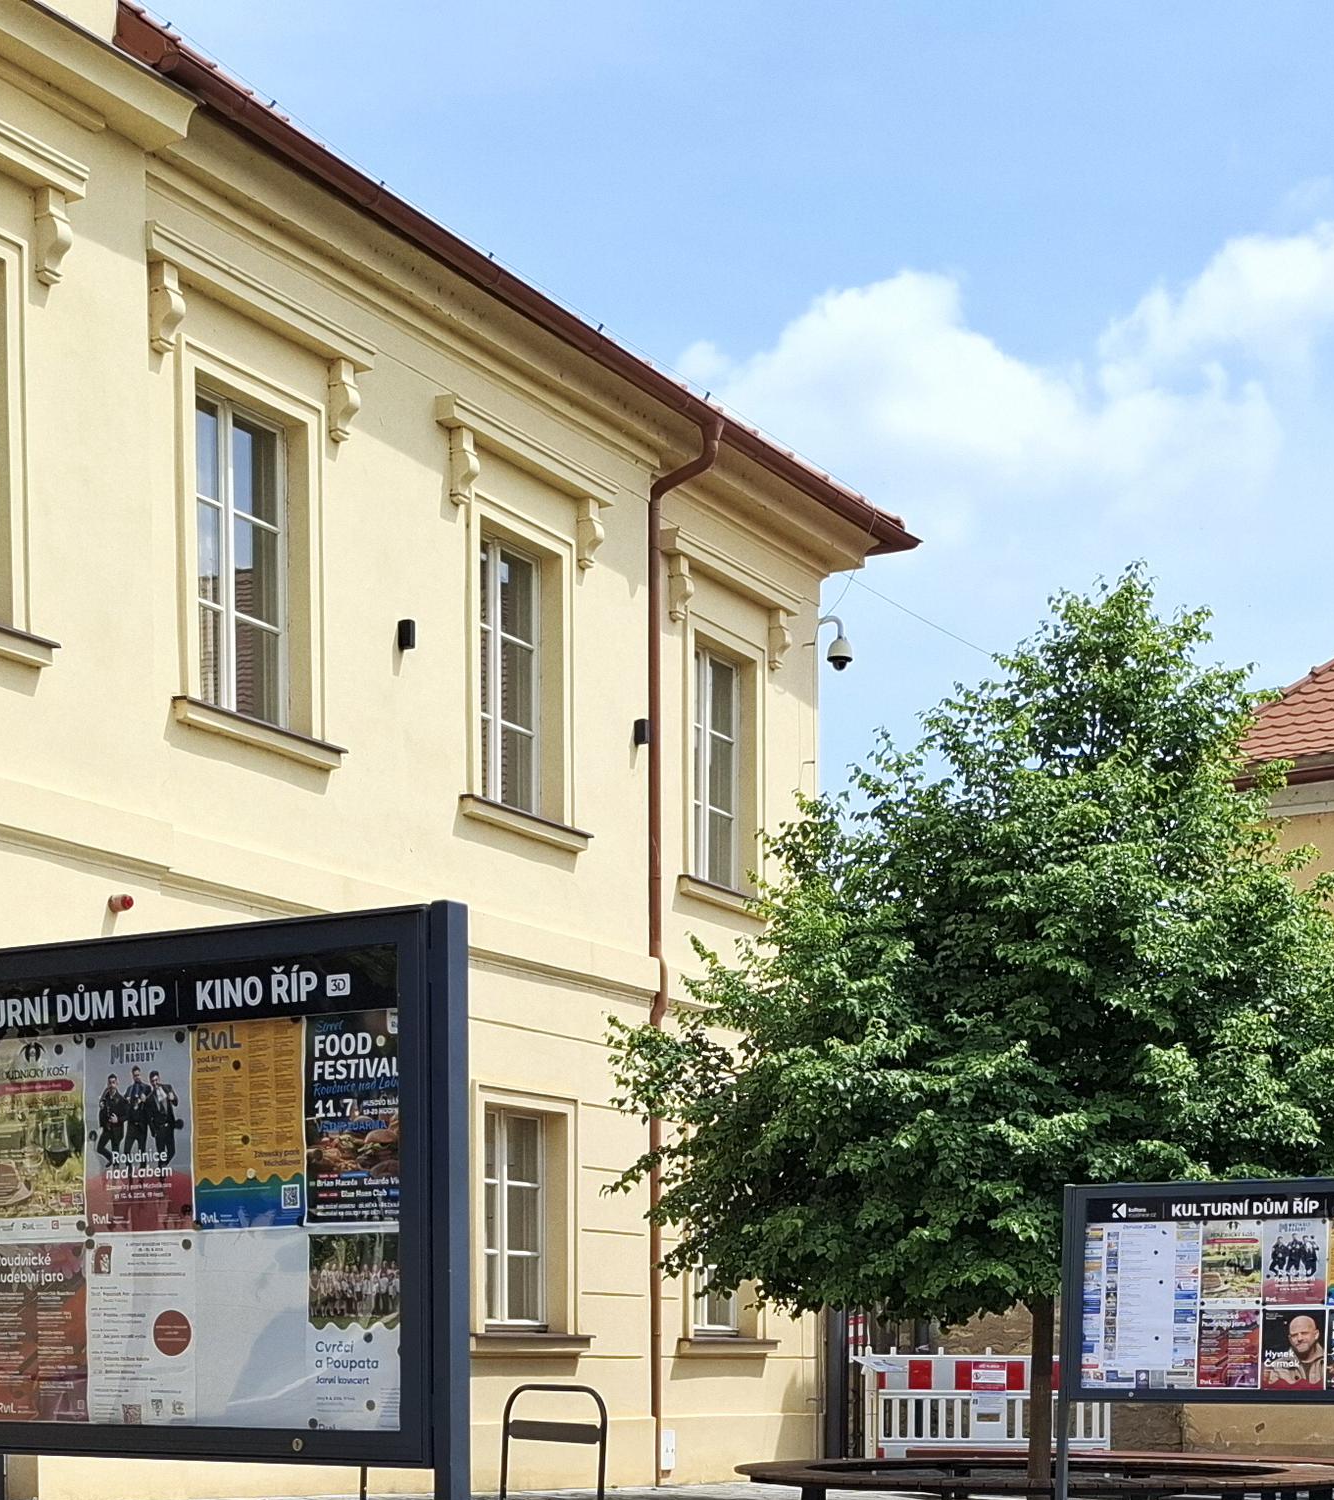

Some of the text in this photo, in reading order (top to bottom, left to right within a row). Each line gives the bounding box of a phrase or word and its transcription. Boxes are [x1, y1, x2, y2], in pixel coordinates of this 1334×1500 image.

[56, 984, 114, 1023] DŮM
[121, 979, 167, 1018] ŘÍP
[195, 976, 263, 1011] KINO
[271, 964, 318, 1005] ŘÍP
[330, 978, 346, 992] 3D
[314, 1032, 372, 1058] FOOD
[47, 1064, 70, 1077] KOŠT
[313, 1056, 399, 1081] FESTIVAL
[313, 1080, 356, 1098] Roudnice
[358, 1077, 377, 1091] nad
[112, 1147, 168, 1164] Roudnice
[105, 1164, 172, 1180] nad Labem
[1171, 1199, 1249, 1217] KULTURNÍ
[1252, 1197, 1289, 1215] DŮM
[1292, 1197, 1320, 1214] ŘÍP
[41, 1271, 64, 1285] jaro
[315, 1340, 354, 1353] Cvrčci
[1264, 1349, 1294, 1359] Hynek
[315, 1357, 379, 1372] a Poupata
[337, 1375, 370, 1385] koncert
